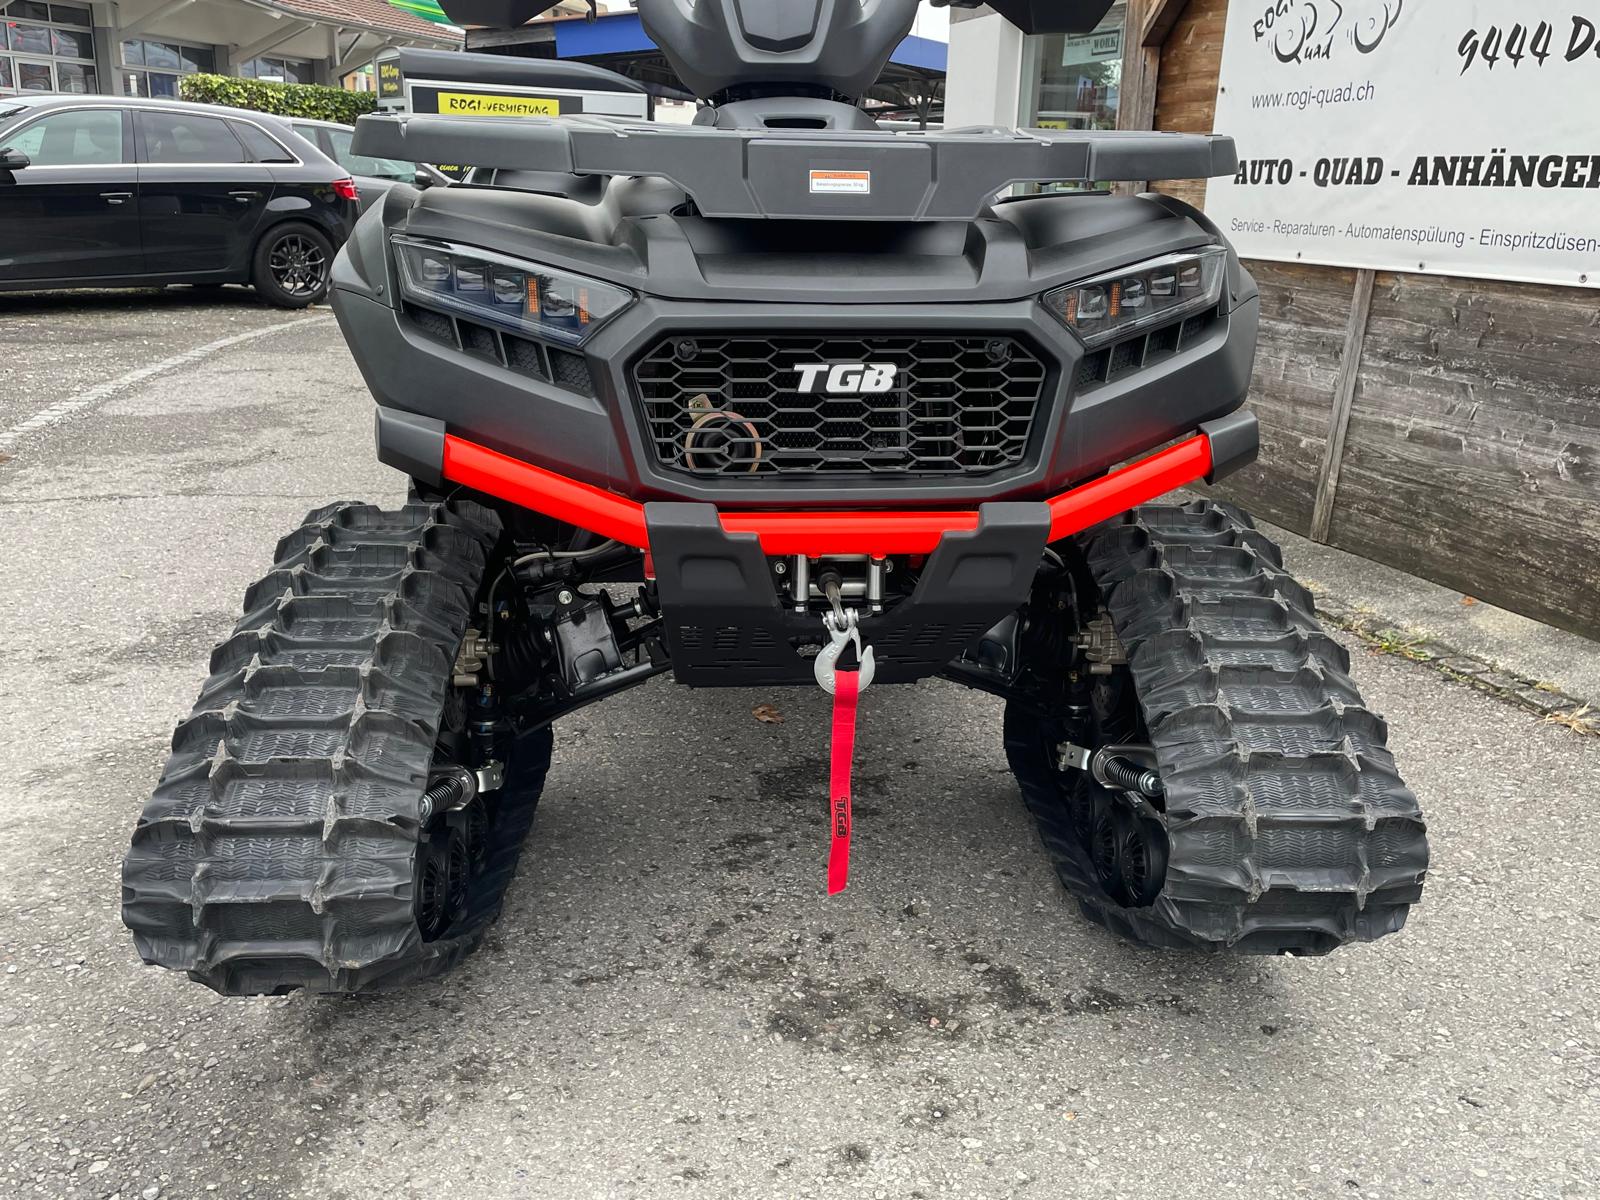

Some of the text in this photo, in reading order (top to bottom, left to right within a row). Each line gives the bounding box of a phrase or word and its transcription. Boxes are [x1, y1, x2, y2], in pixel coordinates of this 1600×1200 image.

[1253, 0, 1294, 42] ROG
[1457, 15, 1600, 76] 9444 D
[1251, 80, 1375, 110] www.rogi-quad.ch
[1233, 158, 1293, 186] AUTO
[1313, 157, 1384, 188] QUAD
[1231, 217, 1265, 233] Service
[1273, 219, 1336, 237] Reparaturen
[1345, 222, 1465, 249] Automatenspülung
[793, 363, 898, 393] TGB
[835, 797, 848, 838] TGB
